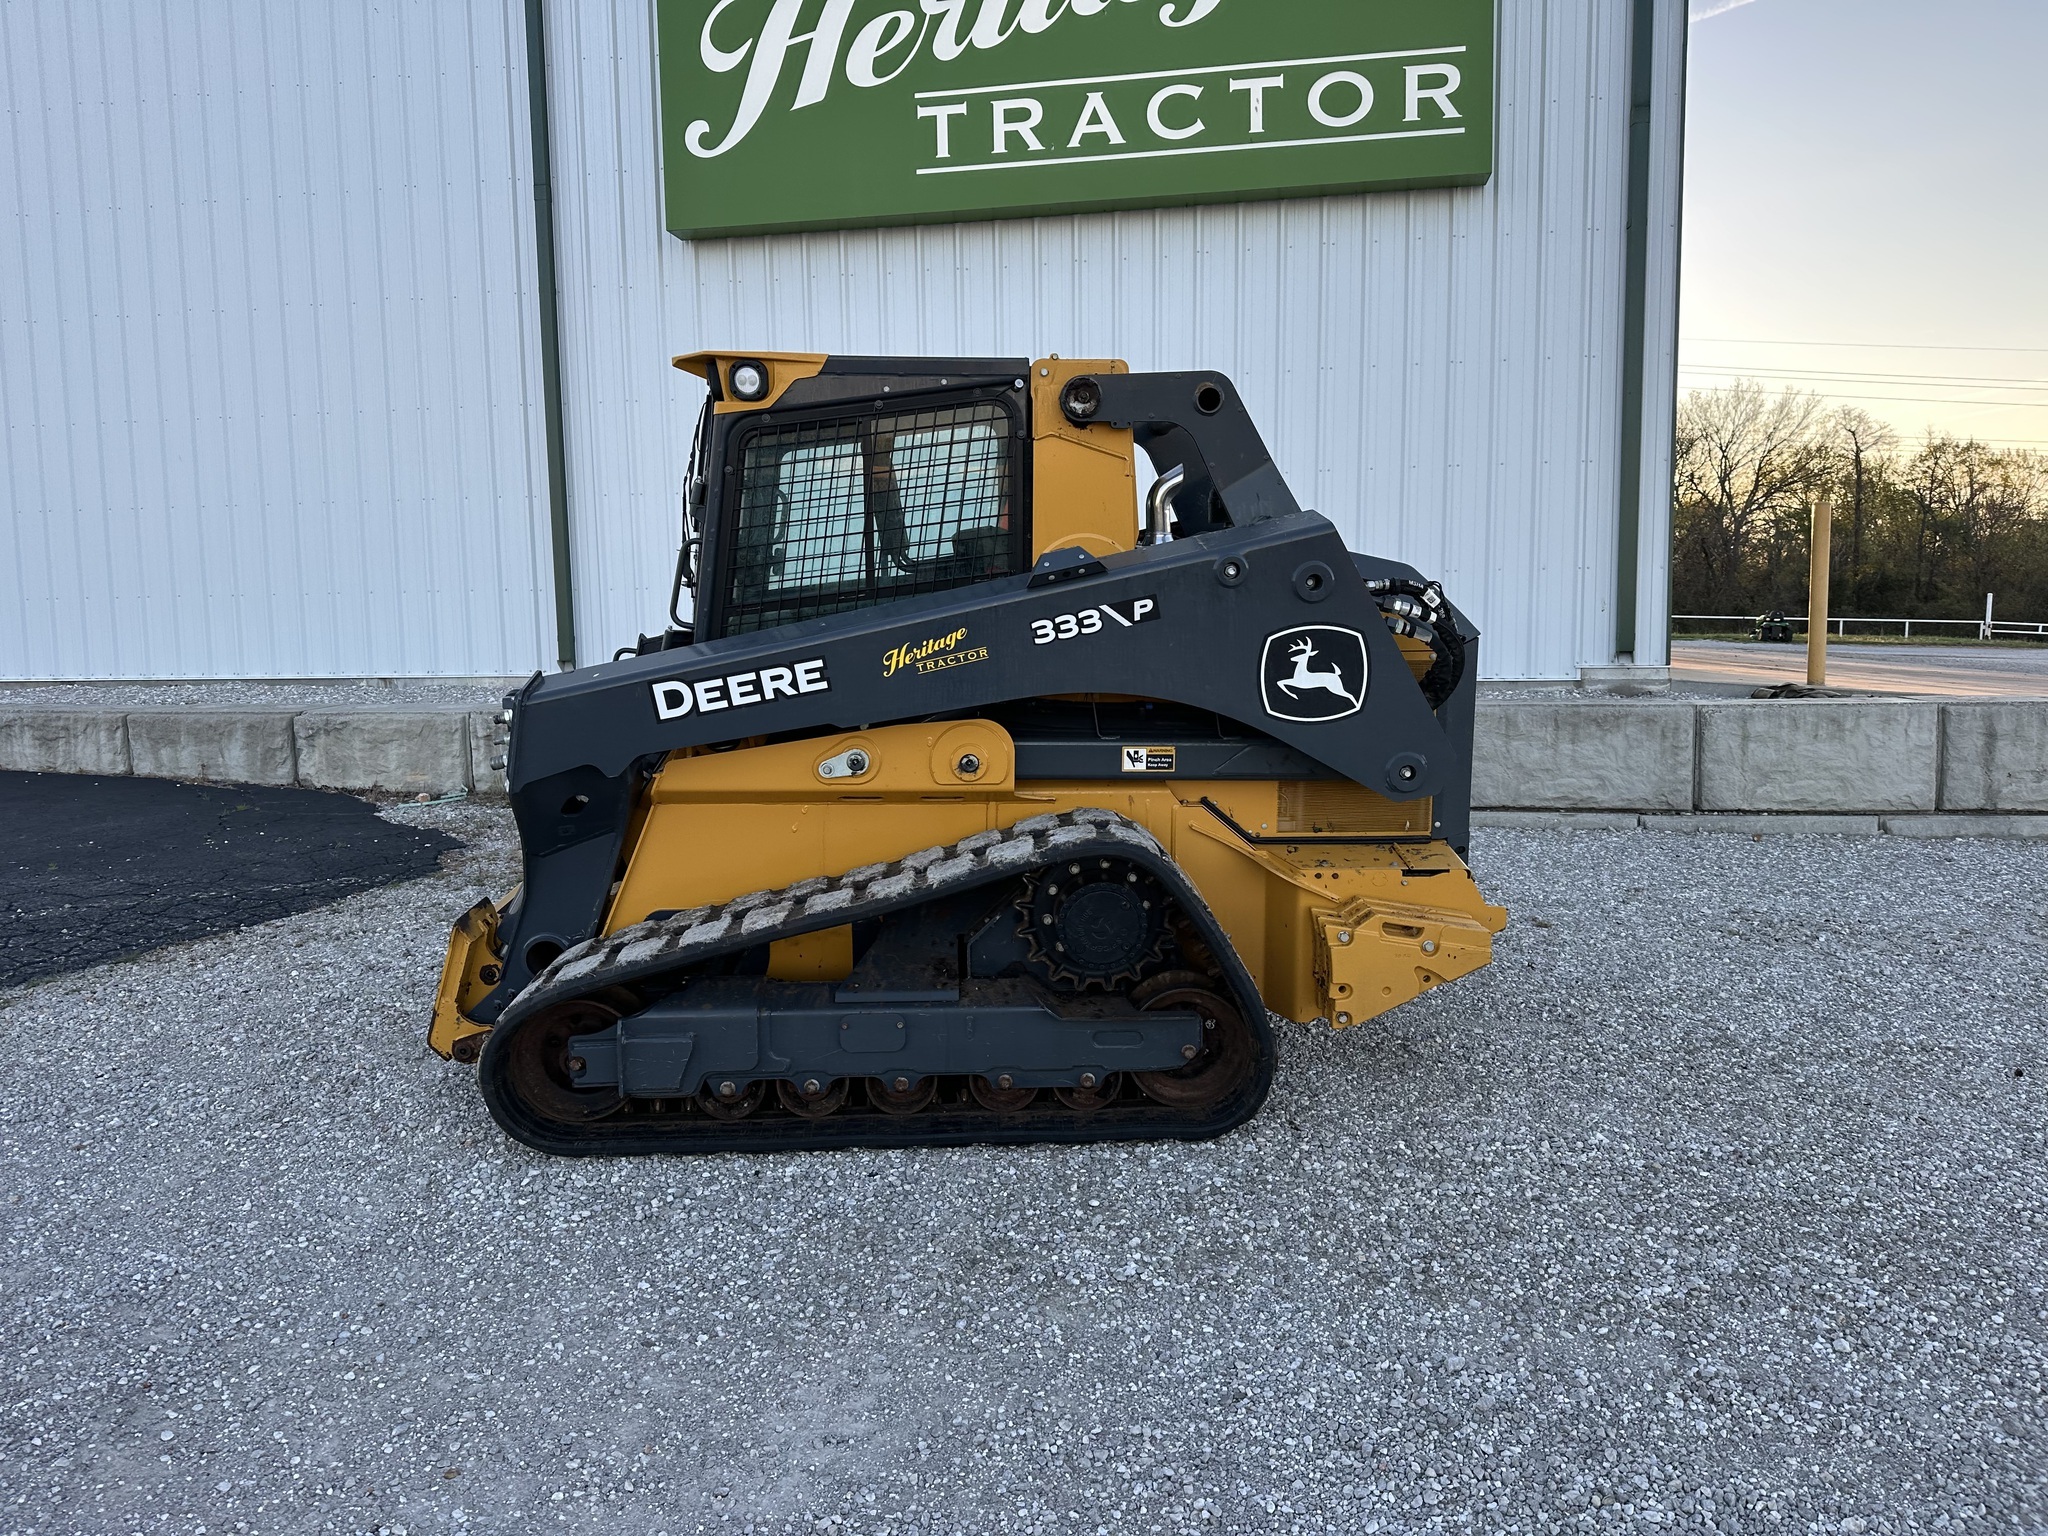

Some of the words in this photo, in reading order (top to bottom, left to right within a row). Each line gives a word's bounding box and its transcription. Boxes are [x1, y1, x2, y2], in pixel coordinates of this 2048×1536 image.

[916, 63, 1463, 159] TRACTOR
[883, 627, 968, 677] Heritage
[915, 649, 988, 671] TRACTOR
[652, 659, 829, 720] DEERE
